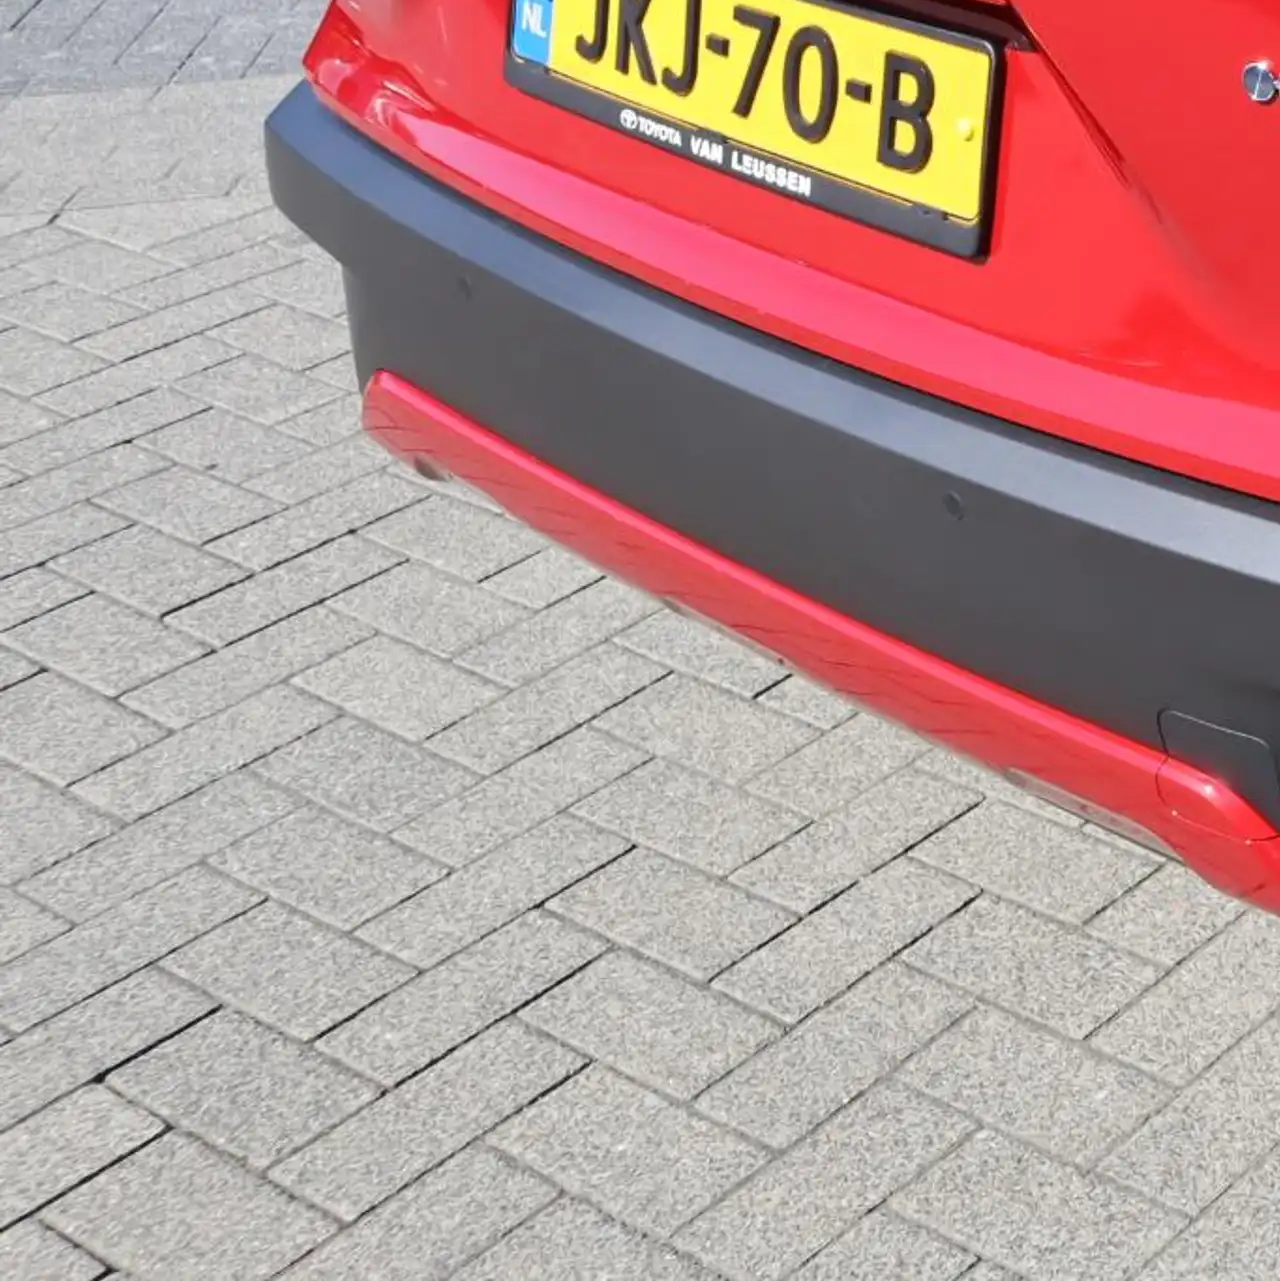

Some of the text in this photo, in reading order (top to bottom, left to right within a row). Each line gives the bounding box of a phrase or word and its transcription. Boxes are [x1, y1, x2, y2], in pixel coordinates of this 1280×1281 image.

[522, 0, 547, 39] NL
[637, 115, 812, 197] TOYOTA VAN LEUSSEN
